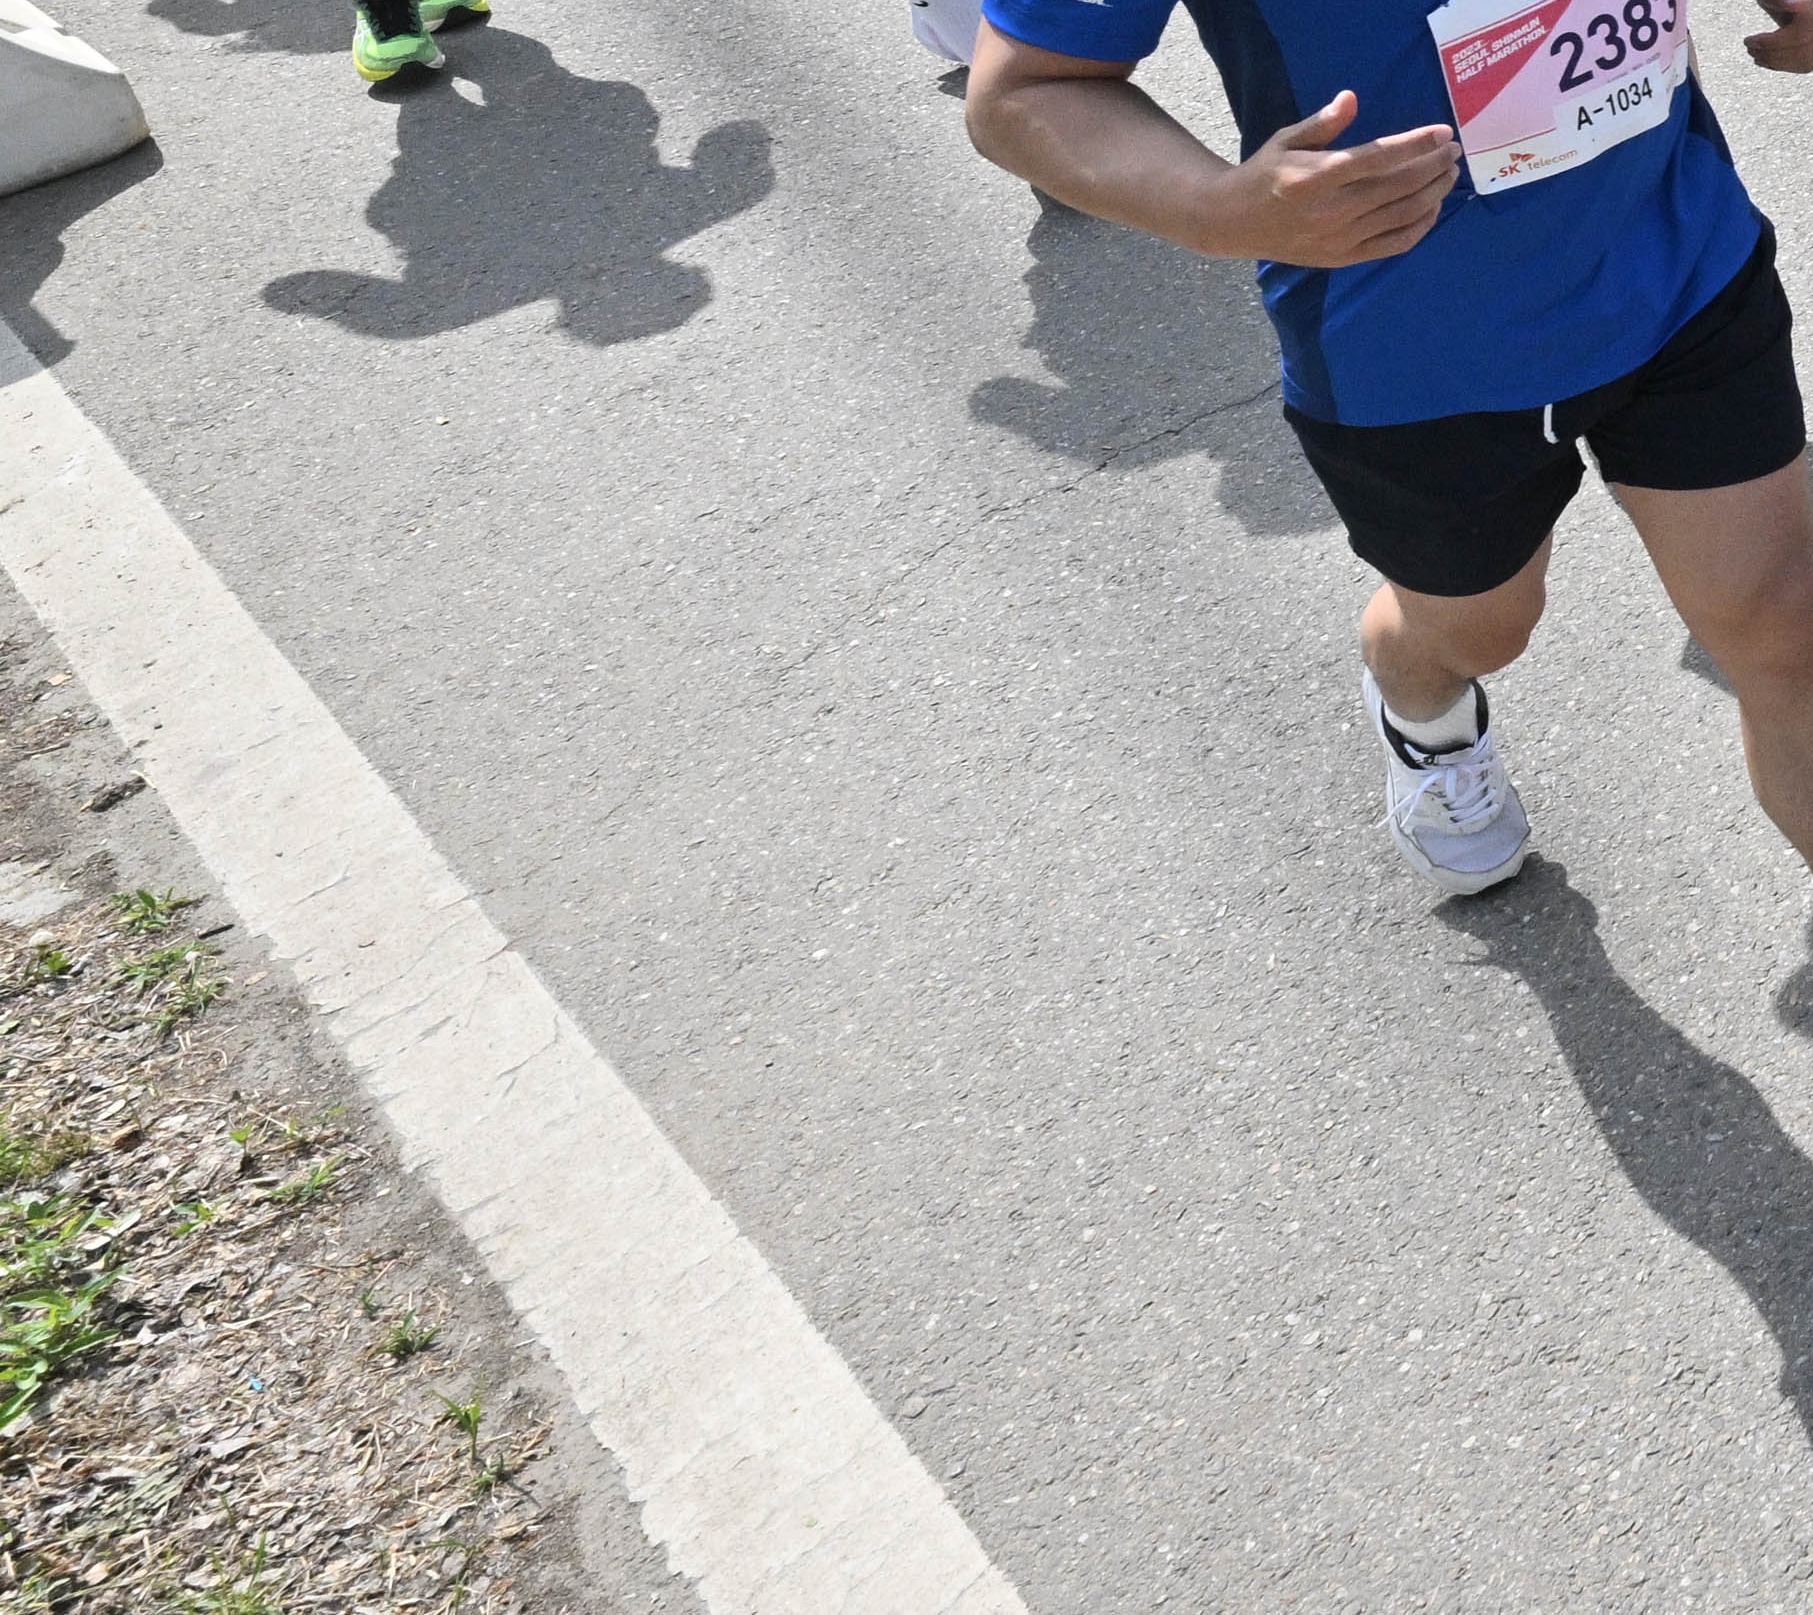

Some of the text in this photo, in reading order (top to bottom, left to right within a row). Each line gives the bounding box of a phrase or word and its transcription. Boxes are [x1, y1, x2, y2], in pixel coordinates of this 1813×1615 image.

[1454, 16, 1541, 74] SEOUL SHINMUN
[1456, 25, 1546, 83] HALF MARATHON
[1576, 76, 1654, 131] A-1034
[1499, 149, 1578, 178] SK telecom
